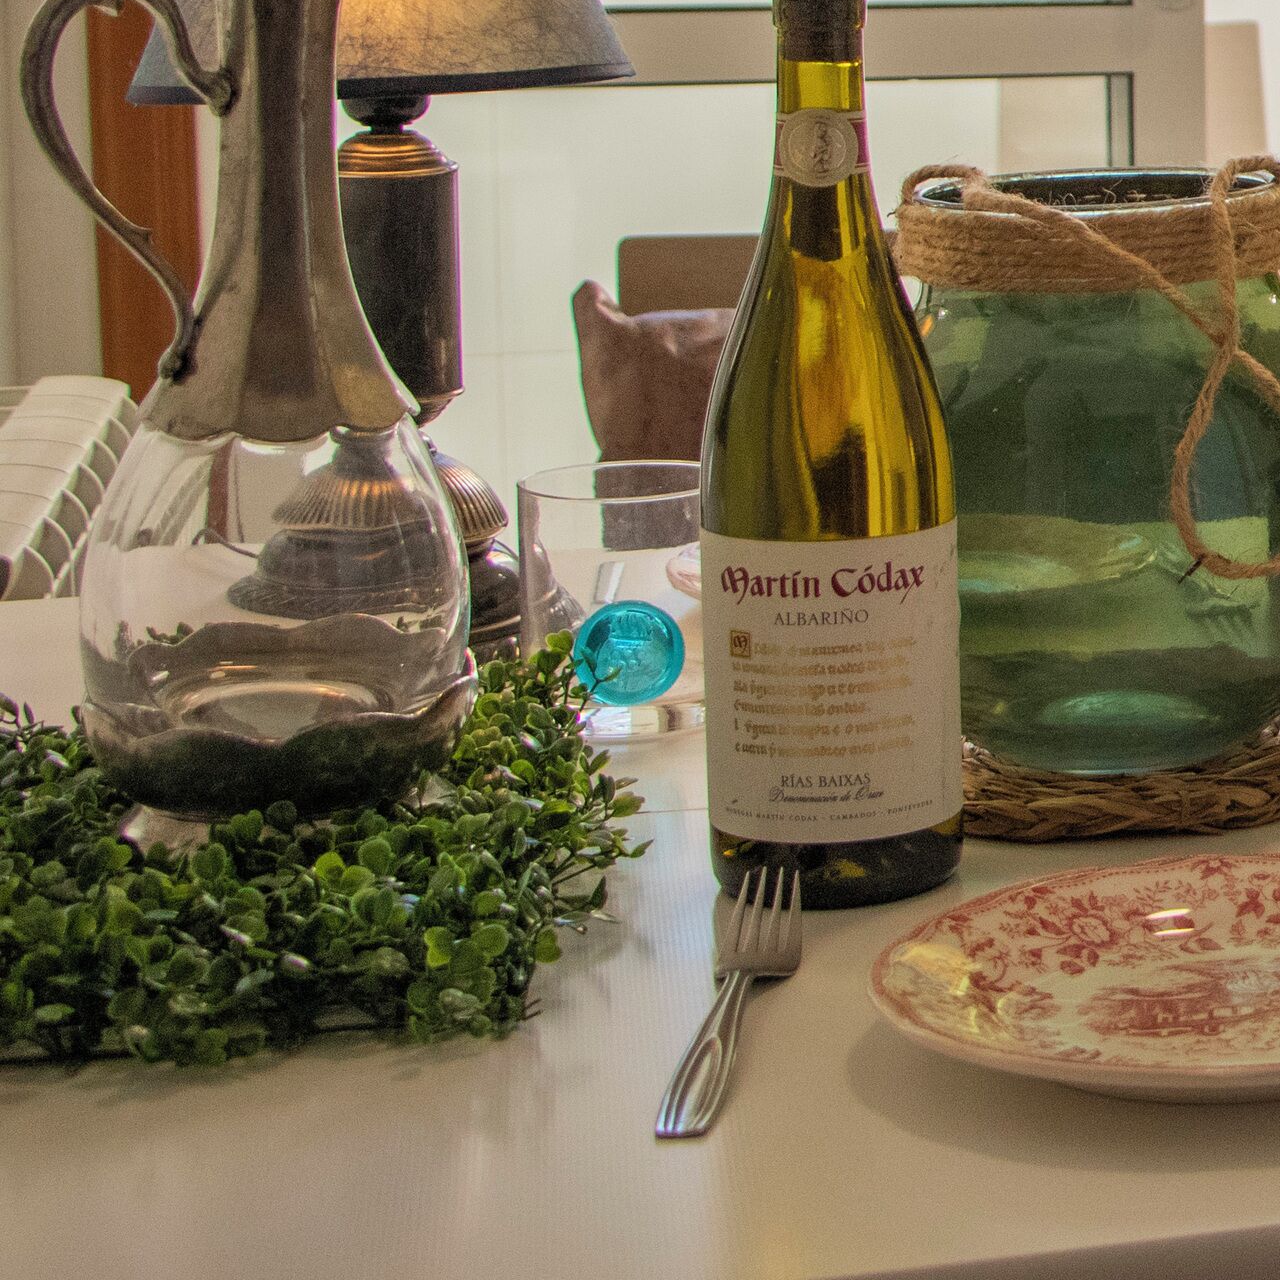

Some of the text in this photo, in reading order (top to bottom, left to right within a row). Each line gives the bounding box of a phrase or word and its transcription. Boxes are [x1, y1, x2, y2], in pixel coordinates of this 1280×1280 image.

[721, 560, 925, 606] Martín Códax
[774, 608, 869, 626] ALBARIÑO
[781, 772, 871, 788] RÍAS BAIXAS
